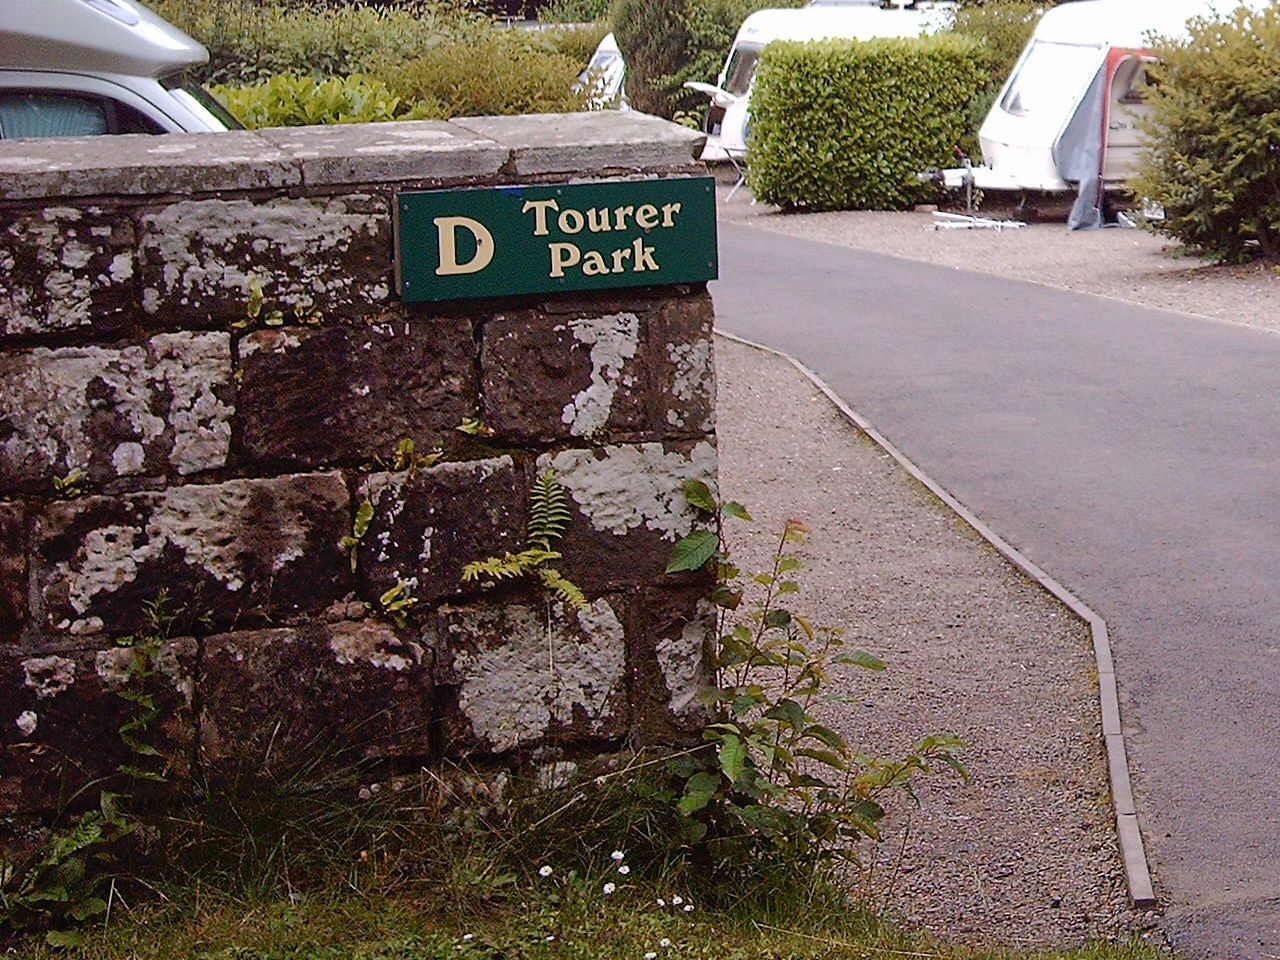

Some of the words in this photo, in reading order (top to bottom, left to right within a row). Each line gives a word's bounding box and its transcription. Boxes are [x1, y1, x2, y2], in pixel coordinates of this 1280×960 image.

[522, 198, 681, 236] Tourer
[433, 216, 495, 276] D
[549, 238, 660, 278] Park
